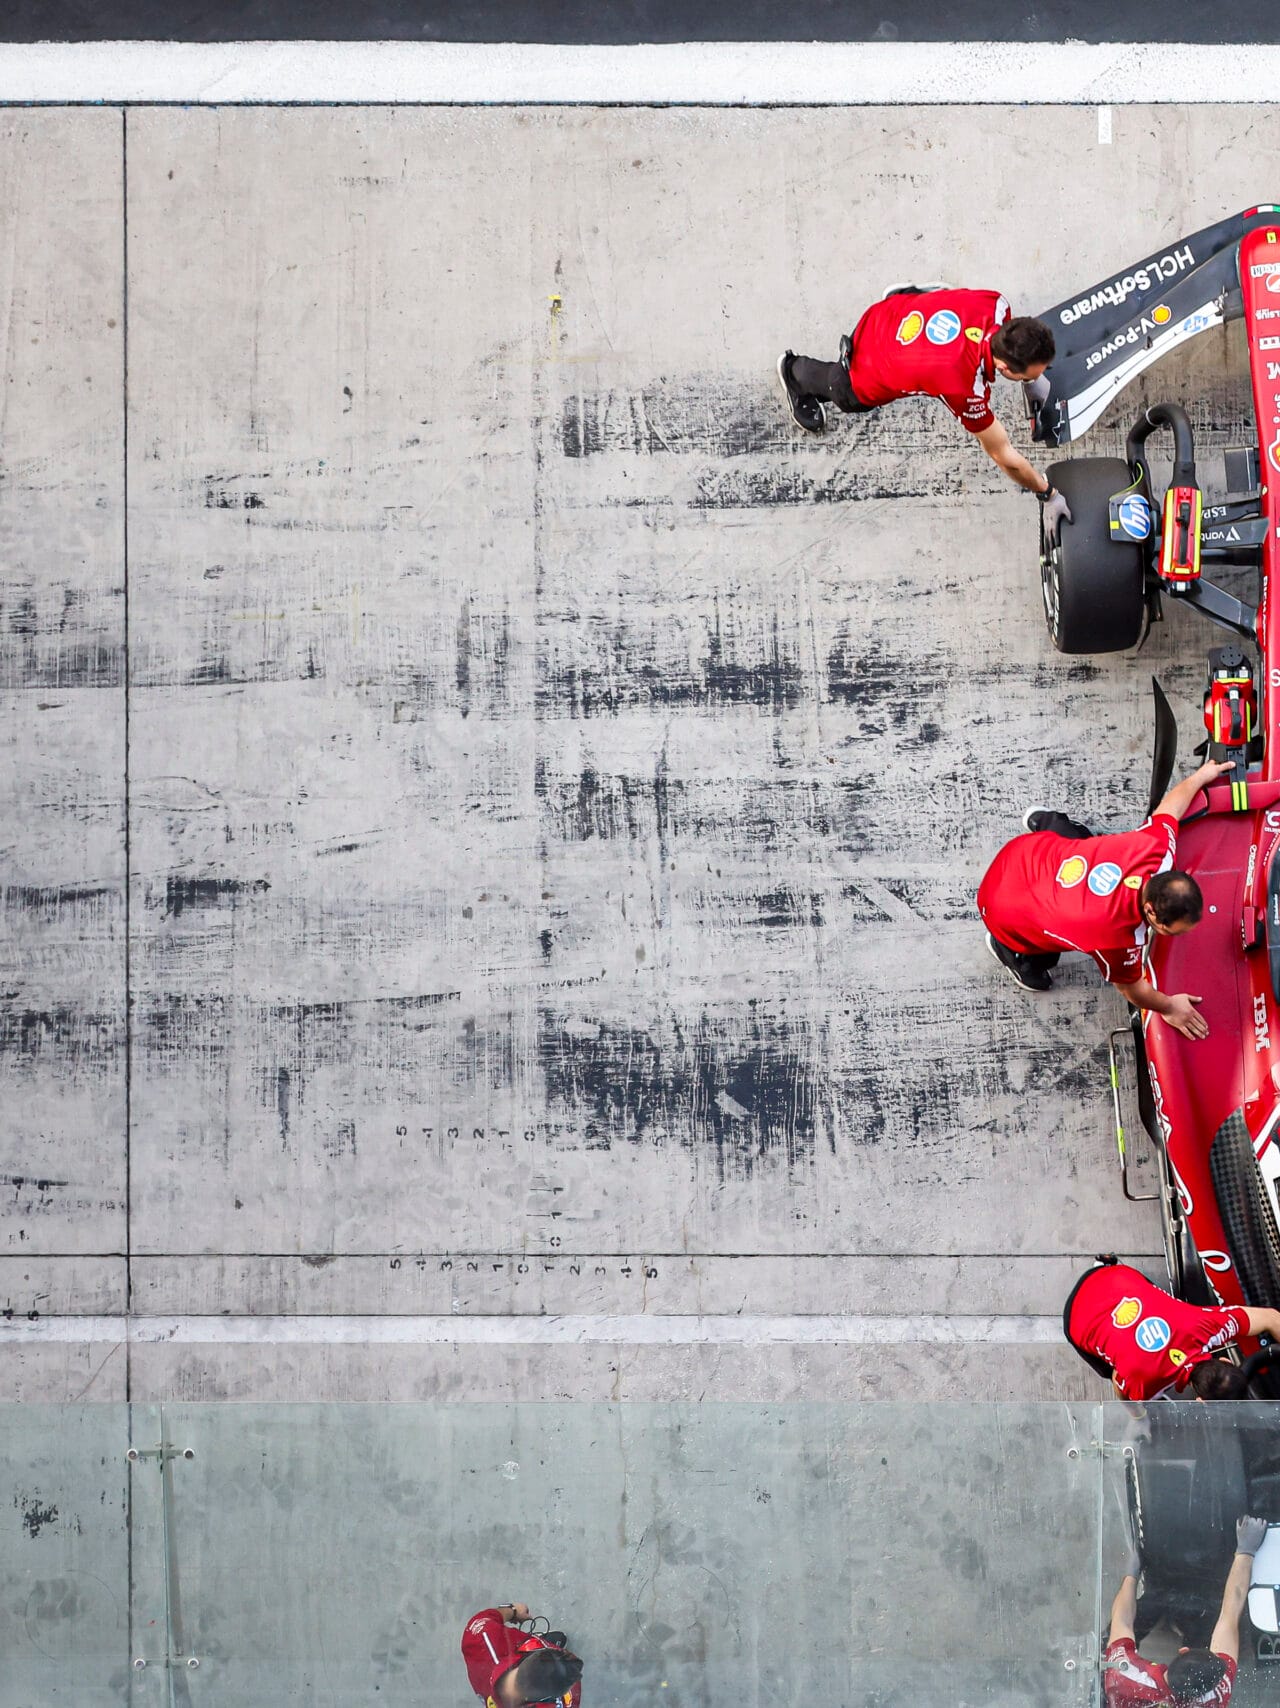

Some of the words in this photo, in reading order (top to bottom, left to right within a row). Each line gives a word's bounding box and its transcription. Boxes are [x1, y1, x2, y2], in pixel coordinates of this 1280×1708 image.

[1060, 245, 1195, 326] HCLSoftware
[926, 310, 960, 344] hp
[1086, 319, 1154, 370] V-Power
[1119, 493, 1151, 539] hp
[1089, 863, 1121, 895] hp
[1254, 993, 1271, 1053] IBM
[1136, 1318, 1169, 1351] hp
